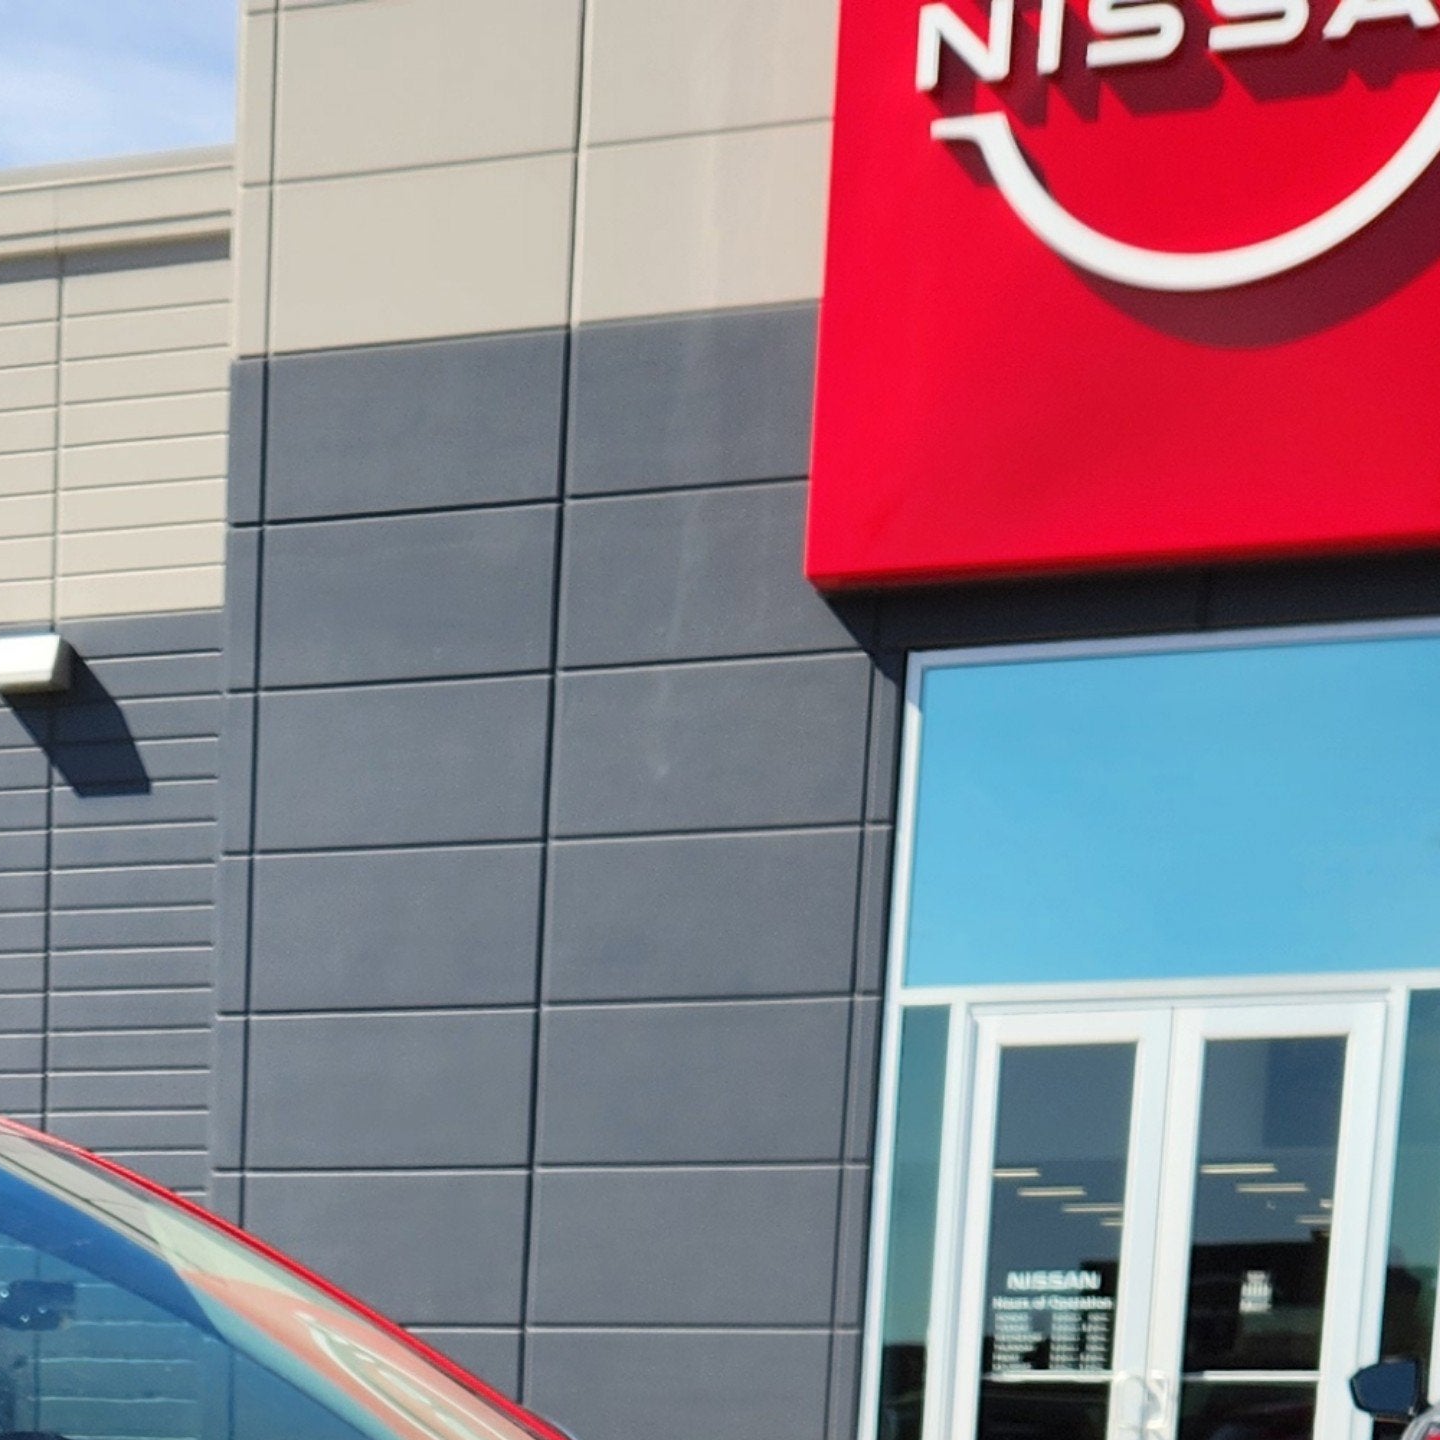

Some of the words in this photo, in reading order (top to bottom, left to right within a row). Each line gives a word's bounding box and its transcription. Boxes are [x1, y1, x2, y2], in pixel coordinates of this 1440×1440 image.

[1006, 1269, 1102, 1290] NISSAN
[992, 1296, 1030, 1309] Hours
[1031, 1294, 1046, 1310] of
[1049, 1294, 1113, 1310] Operation
